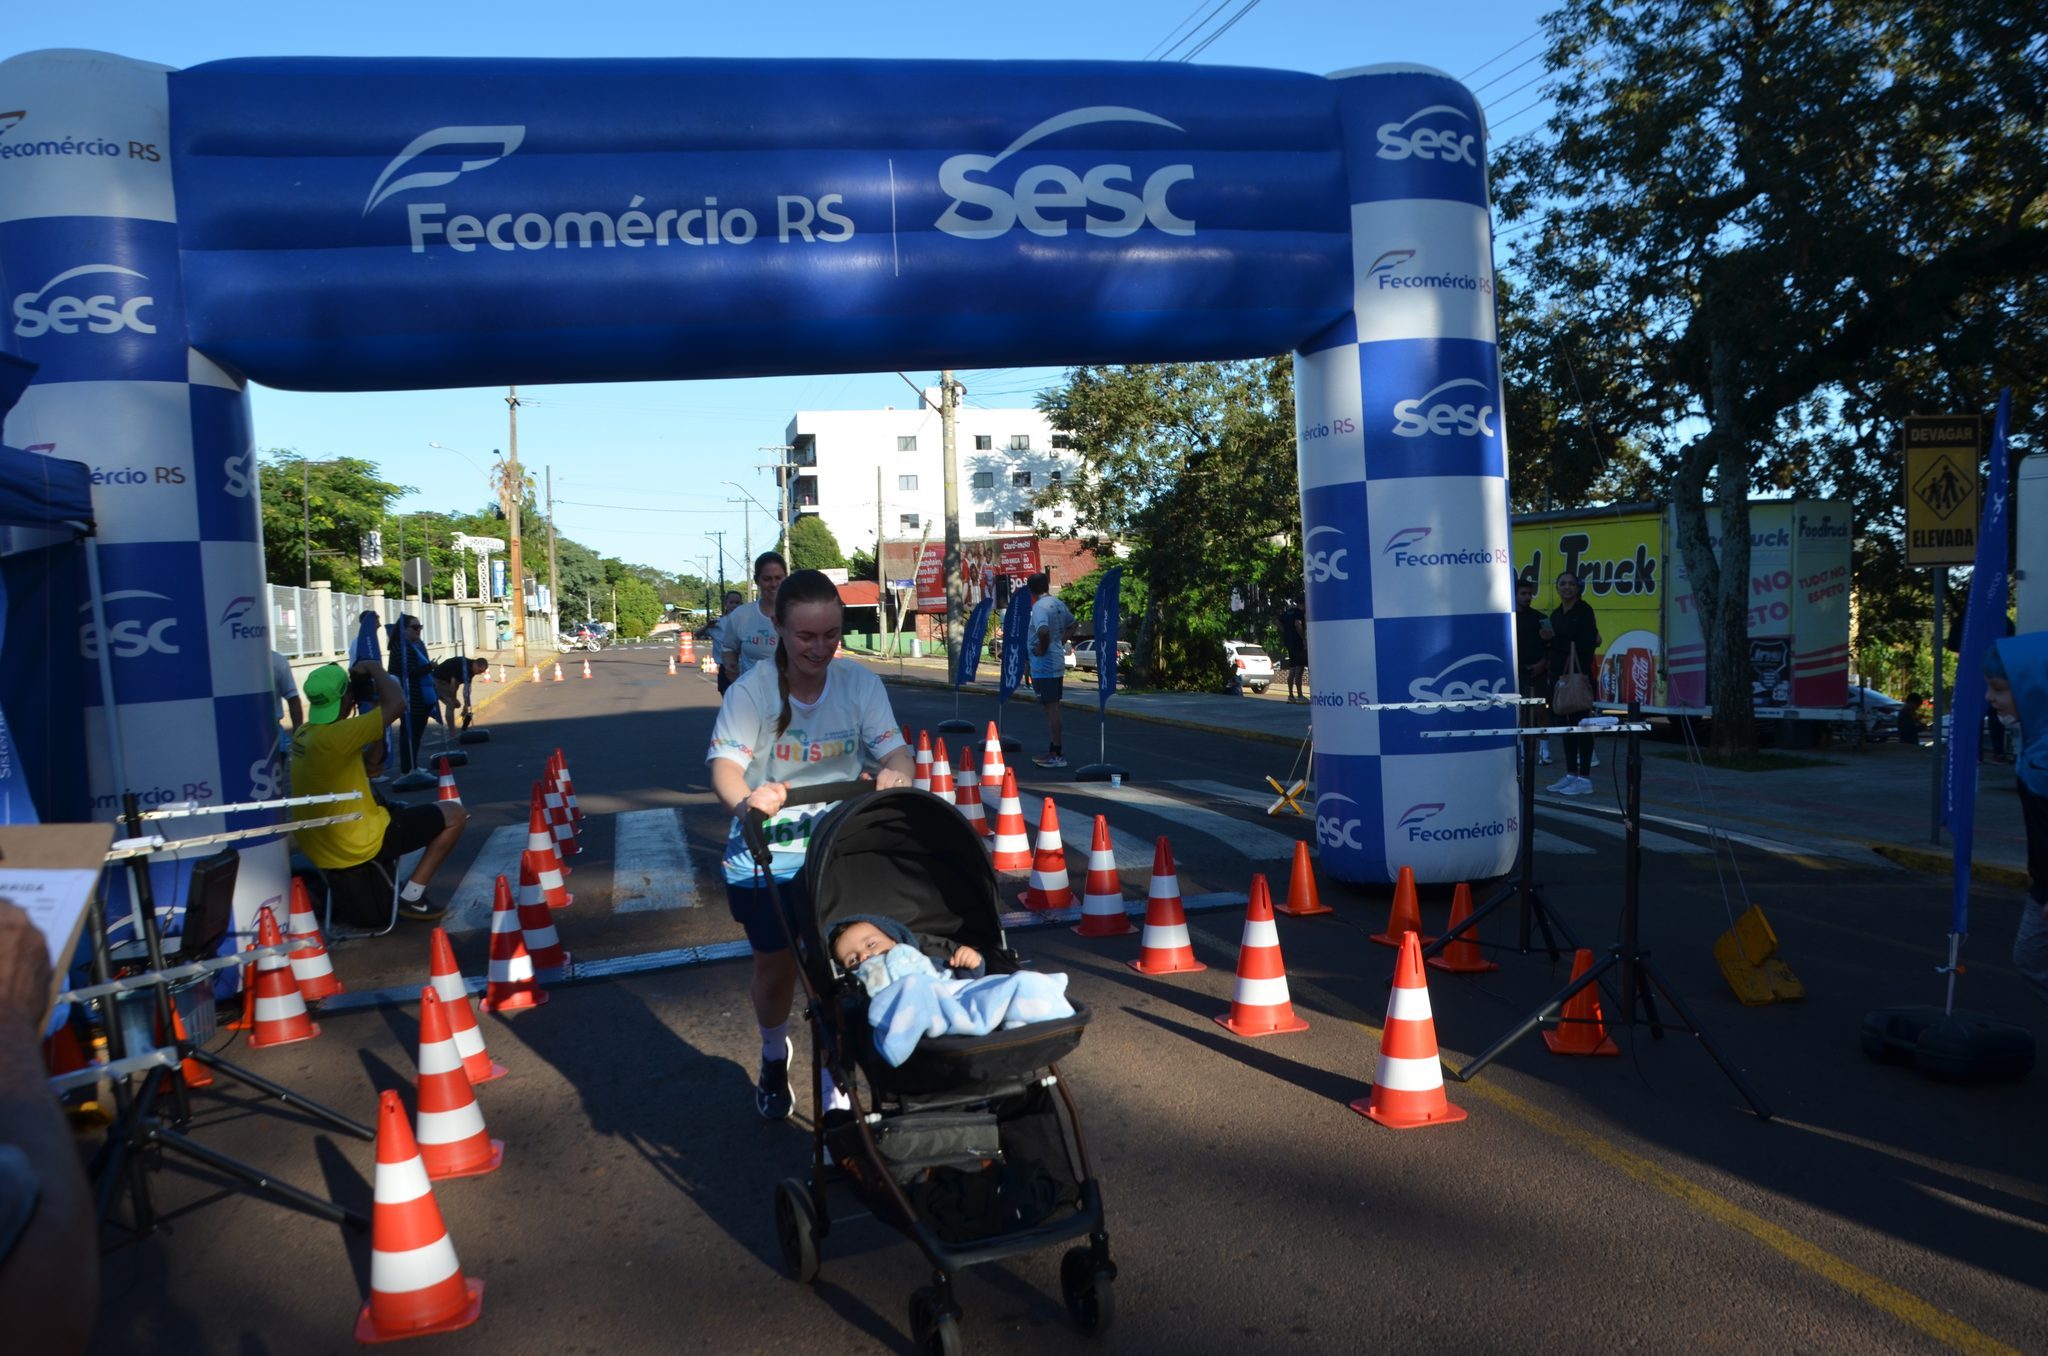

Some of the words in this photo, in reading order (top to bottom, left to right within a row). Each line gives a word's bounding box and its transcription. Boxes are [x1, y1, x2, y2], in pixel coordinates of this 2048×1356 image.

[0, 136, 120, 160] ecomércio
[128, 141, 161, 162] RS
[1376, 123, 1477, 167] Sesc
[408, 195, 758, 252] Fecomércio
[779, 193, 855, 243] RS
[934, 153, 1197, 240] Sesc
[1379, 272, 1477, 291] Fecomércio
[1479, 278, 1492, 295] RS
[13, 292, 157, 338] Sesc
[1333, 418, 1355, 435] RS
[1392, 399, 1495, 437] Sesc
[1911, 427, 1973, 442] DEVAGAR
[155, 466, 186, 485] RS
[1913, 528, 1974, 548] ELEVADA
[1394, 543, 1493, 568] Fecomércio
[1495, 548, 1508, 565] RS
[1559, 533, 1657, 597] Truck
[1347, 691, 1371, 707] RS
[183, 780, 213, 802] RS
[1408, 821, 1504, 843] Fecomércio
[1507, 816, 1519, 833] RS
